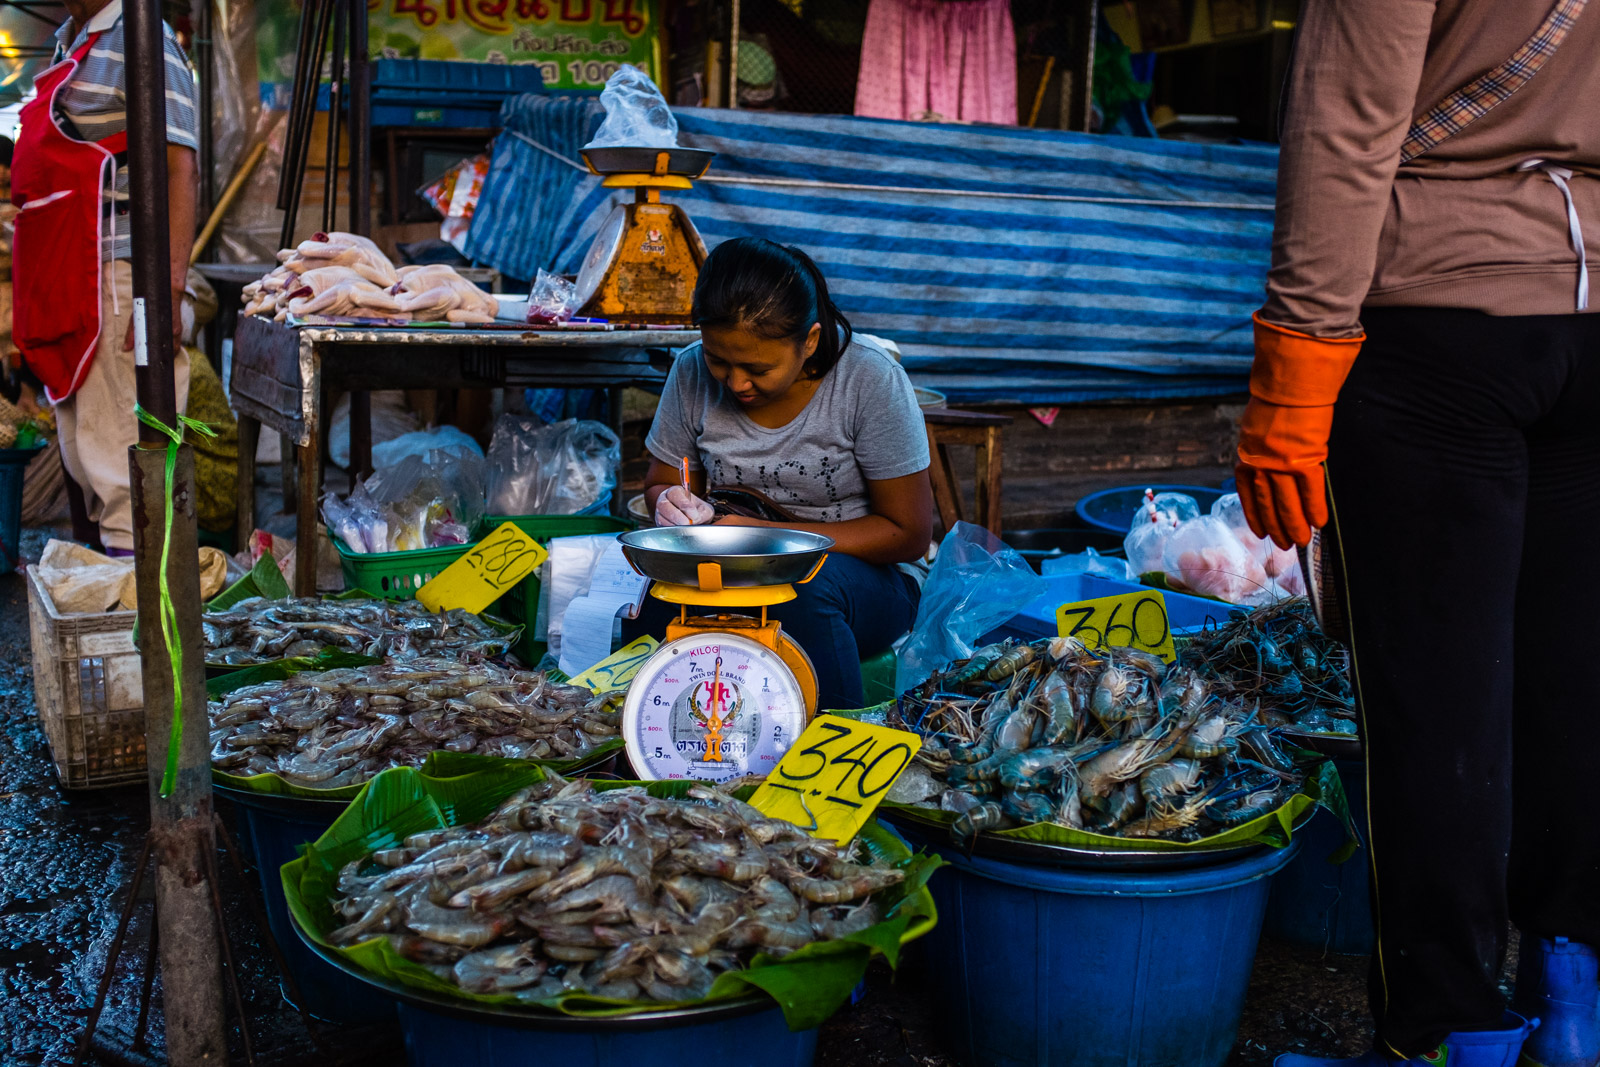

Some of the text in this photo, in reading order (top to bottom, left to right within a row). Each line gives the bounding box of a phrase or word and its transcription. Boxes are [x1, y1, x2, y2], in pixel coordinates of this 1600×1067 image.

[470, 528, 538, 585] 280
[1064, 597, 1168, 649] 360
[779, 722, 912, 799] 340
